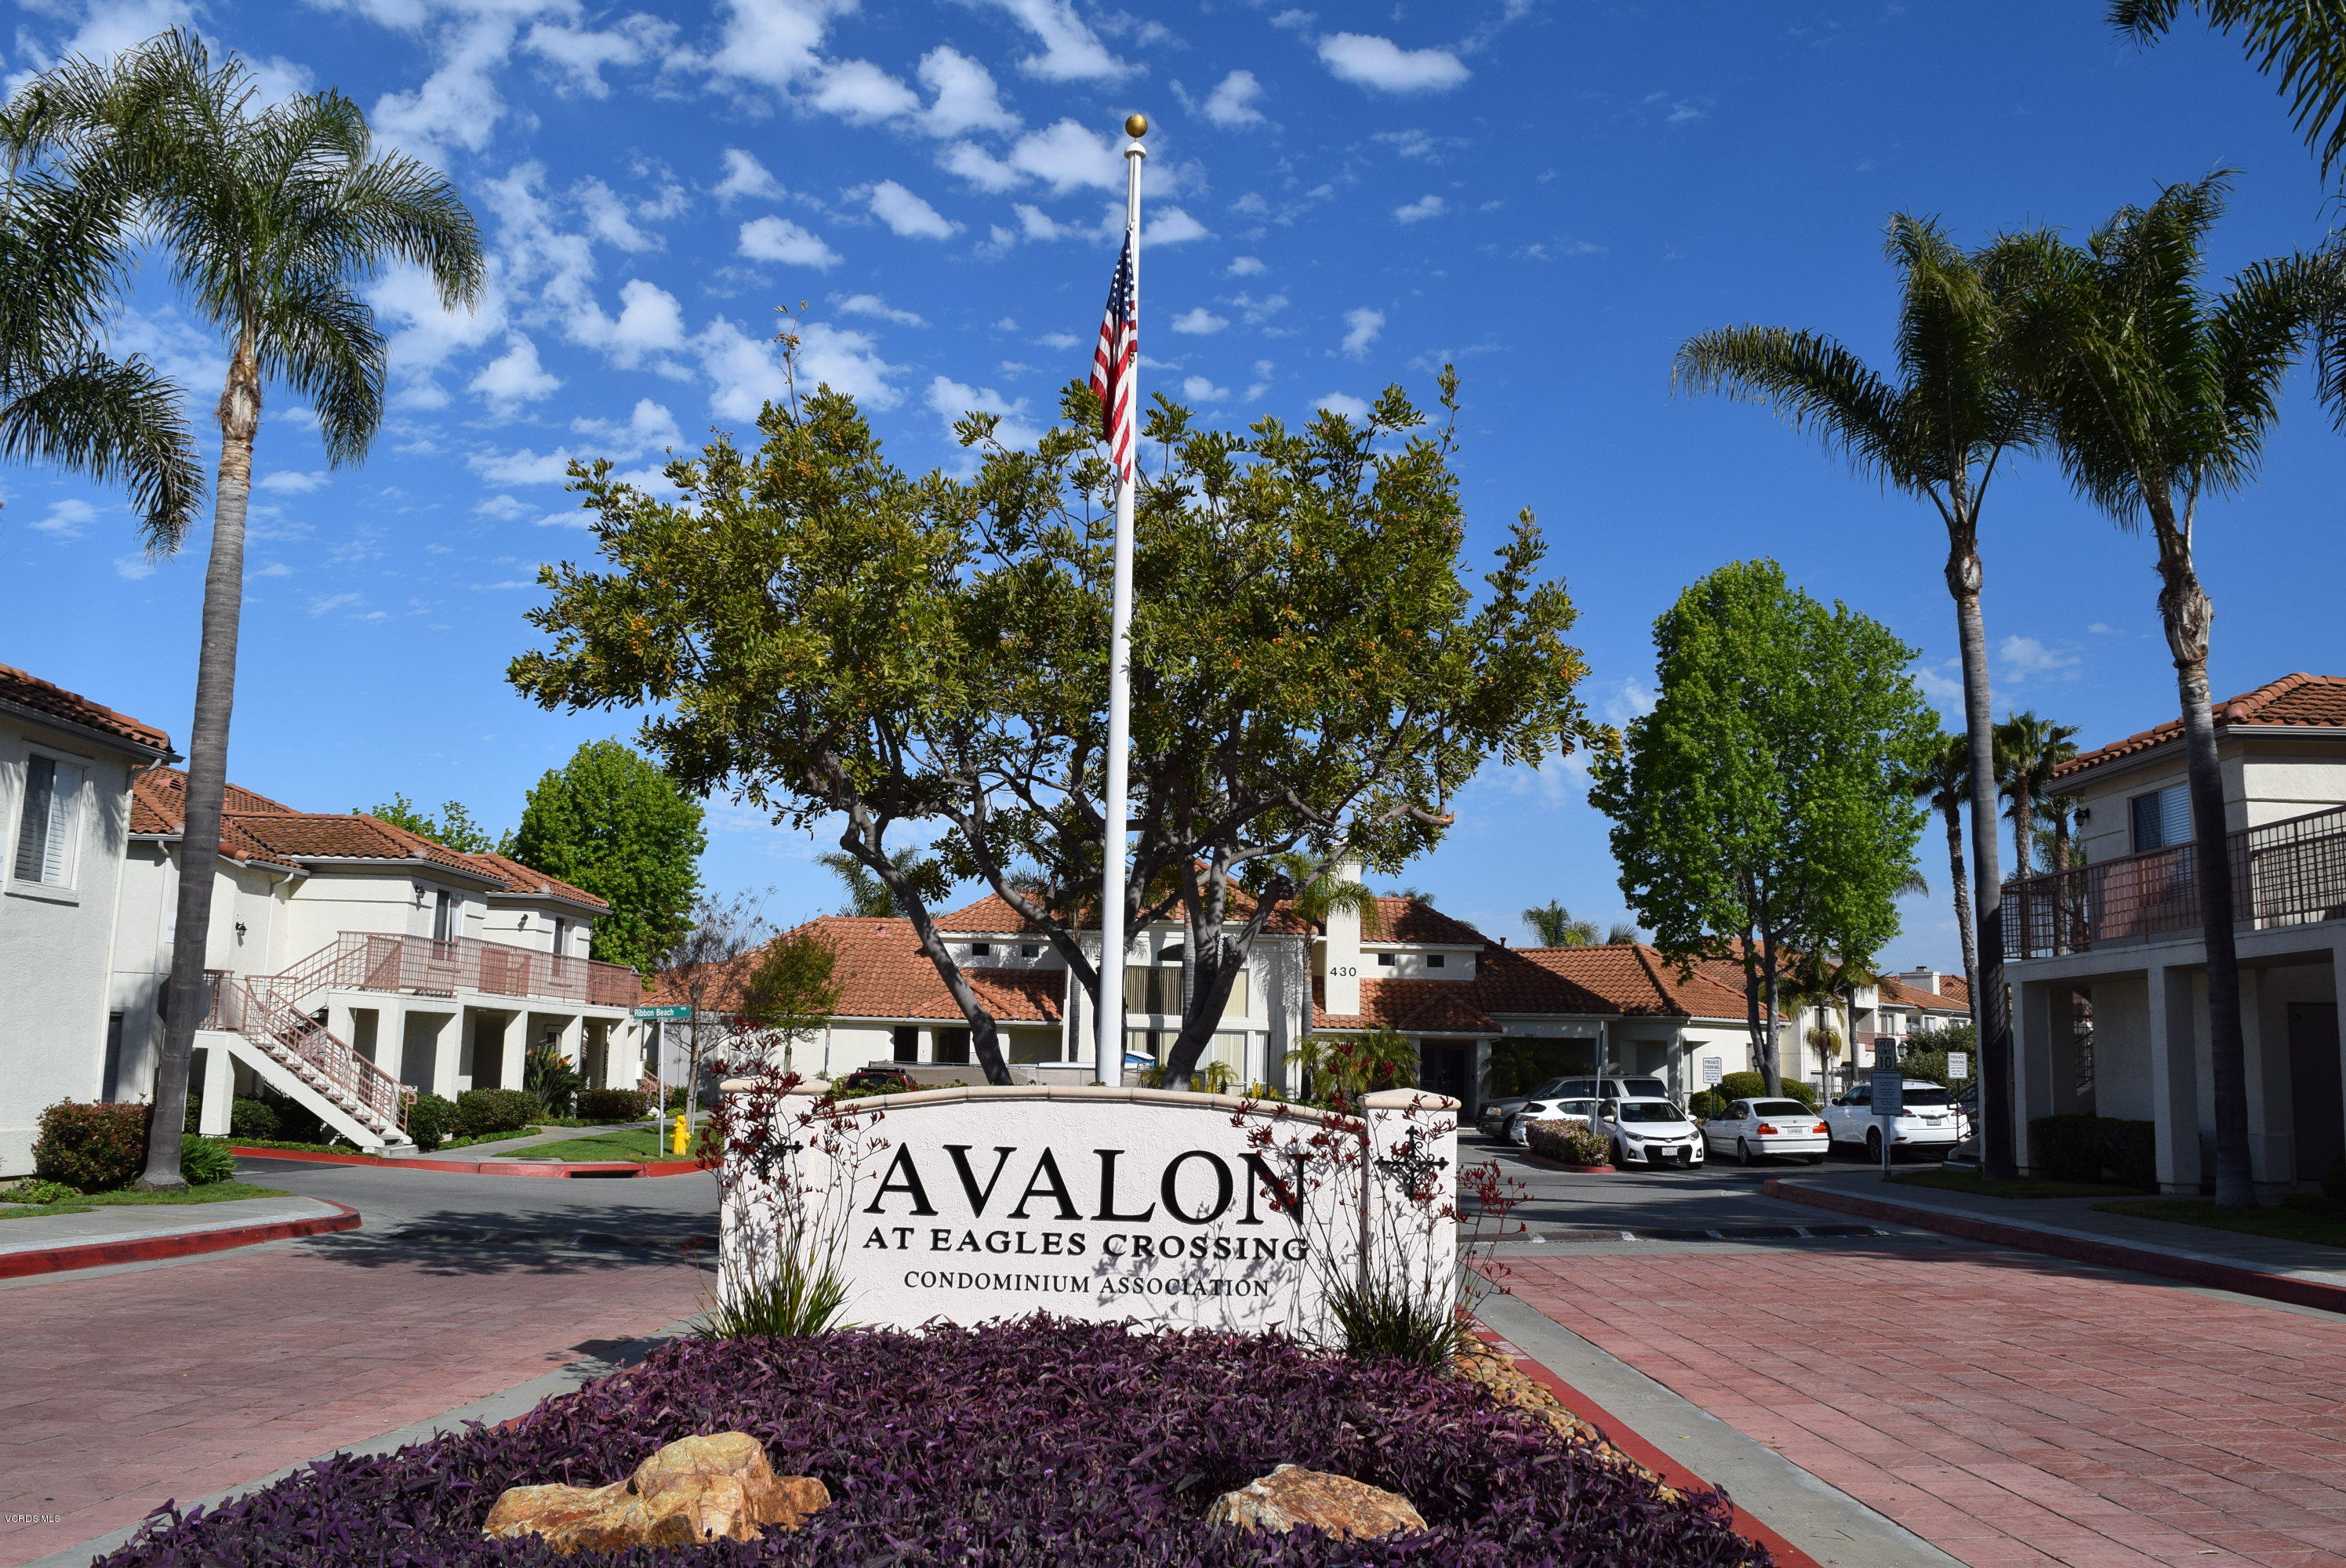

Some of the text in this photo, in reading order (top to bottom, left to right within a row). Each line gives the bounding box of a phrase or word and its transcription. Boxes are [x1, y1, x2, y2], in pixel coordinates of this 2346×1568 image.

[1330, 967, 1356, 977] 430
[1879, 1056, 1892, 1069] 10
[862, 1142, 1314, 1226] AVALON
[862, 1227, 1309, 1261] AT EAGLES CROSSING
[904, 1271, 1269, 1297] CONDOMINIUM ASSOCIATION
